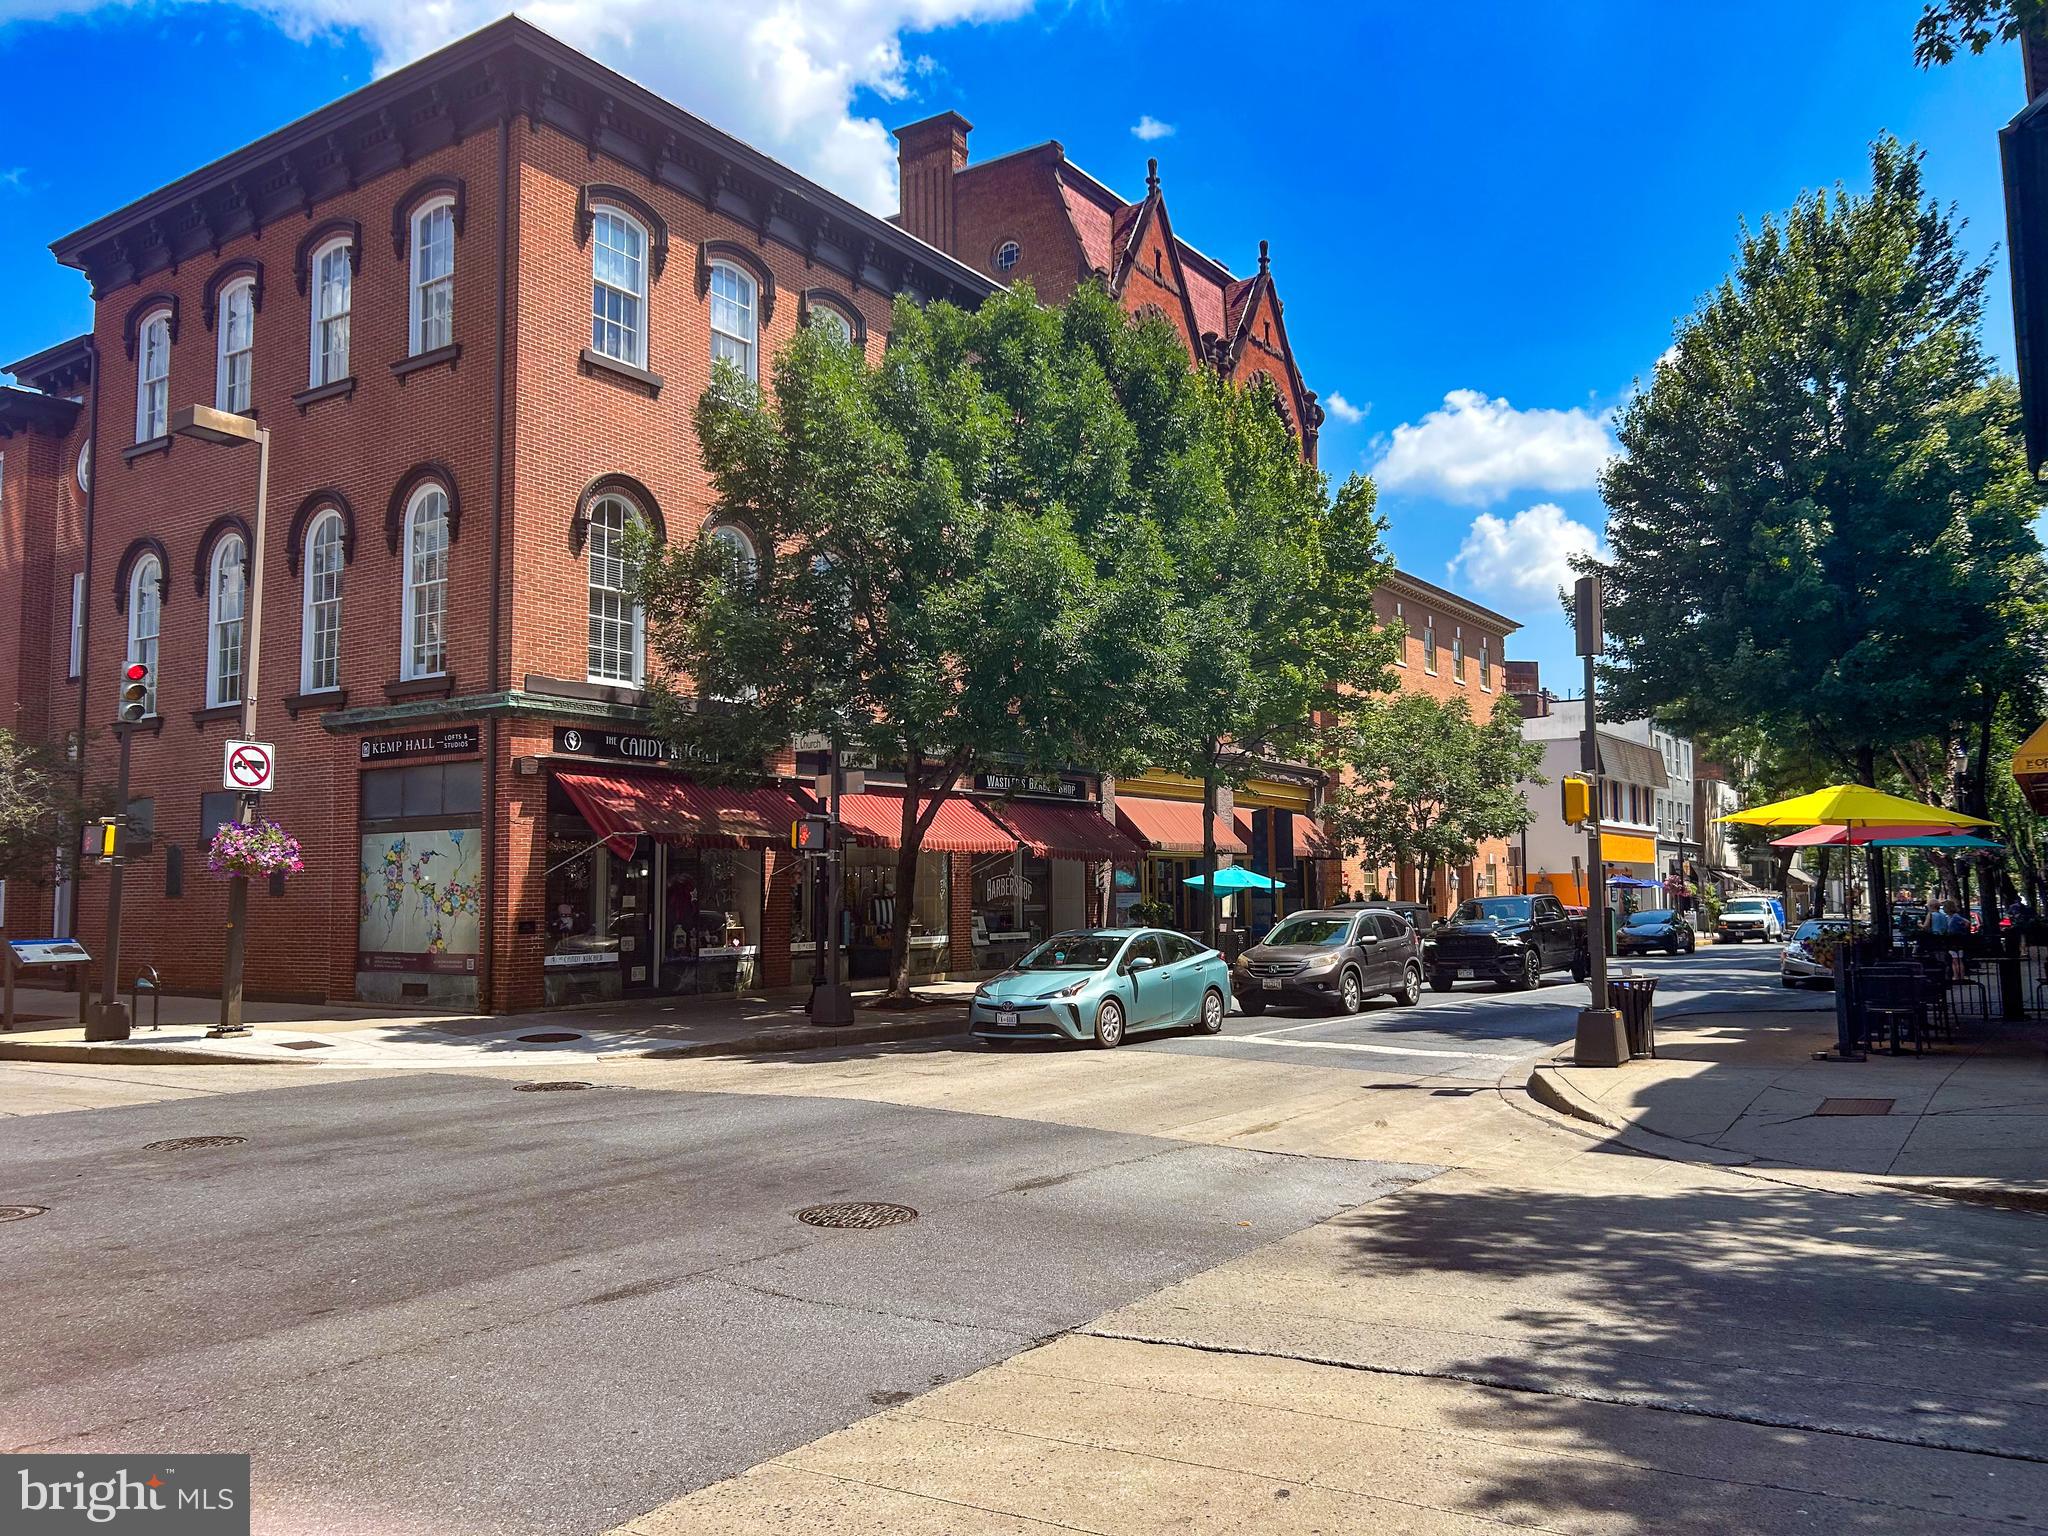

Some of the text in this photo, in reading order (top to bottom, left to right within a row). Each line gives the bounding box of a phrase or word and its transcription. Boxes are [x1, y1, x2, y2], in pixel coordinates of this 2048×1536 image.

[372, 738, 435, 754] KEMP HALL
[444, 741, 469, 749] STUDIOS
[606, 736, 617, 745] THE
[620, 736, 665, 758] CANDY
